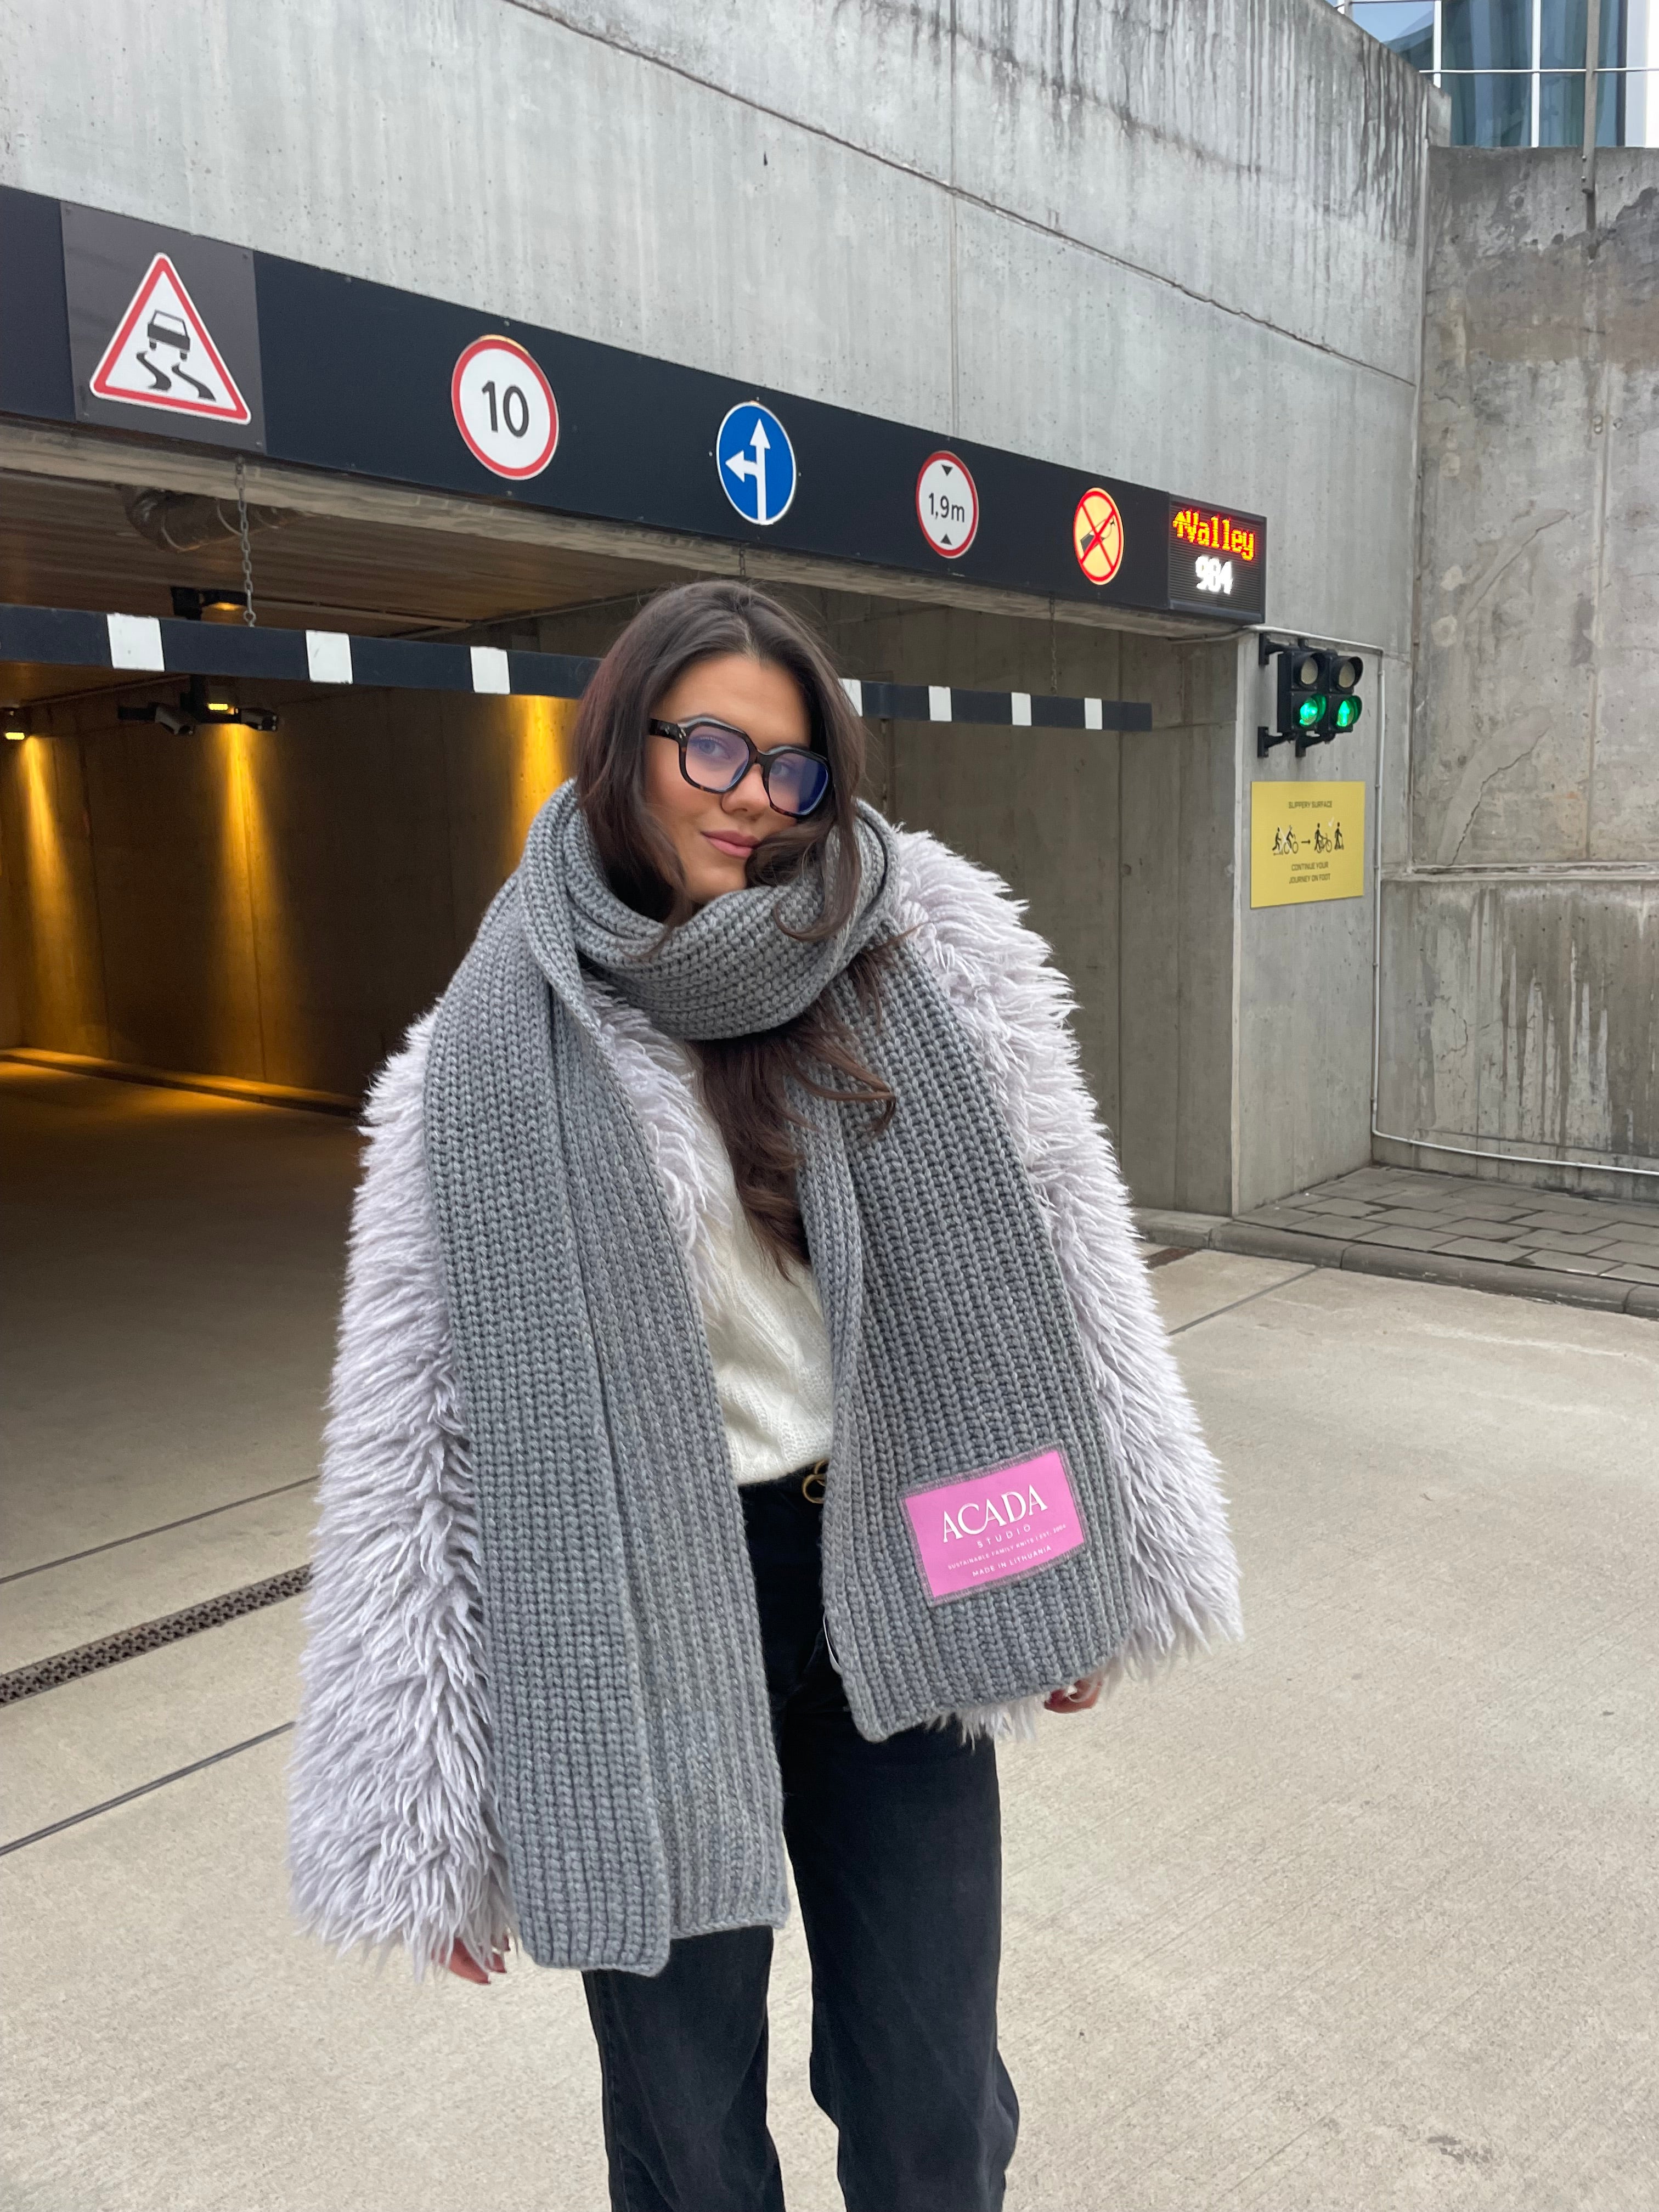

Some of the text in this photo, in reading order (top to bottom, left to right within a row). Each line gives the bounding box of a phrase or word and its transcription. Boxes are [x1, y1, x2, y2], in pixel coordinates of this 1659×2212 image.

[482, 380, 529, 438] 10
[928, 492, 965, 523] 1,9m
[1185, 510, 1255, 561] Valley
[1289, 875, 1311, 884] JOURNEY
[1319, 873, 1331, 882] FOOT
[1291, 861, 1329, 871] CONTINUE YOUR
[943, 1484, 1048, 1543] ACADA
[977, 1523, 1031, 1548] STUDIO
[947, 1553, 990, 1570] SUSTAINABLE
[991, 1545, 1014, 1556] FAMILY
[1015, 1538, 1034, 1548] KNITS
[972, 1565, 995, 1577] MADE
[1009, 1545, 1052, 1566] LITHUANIA
